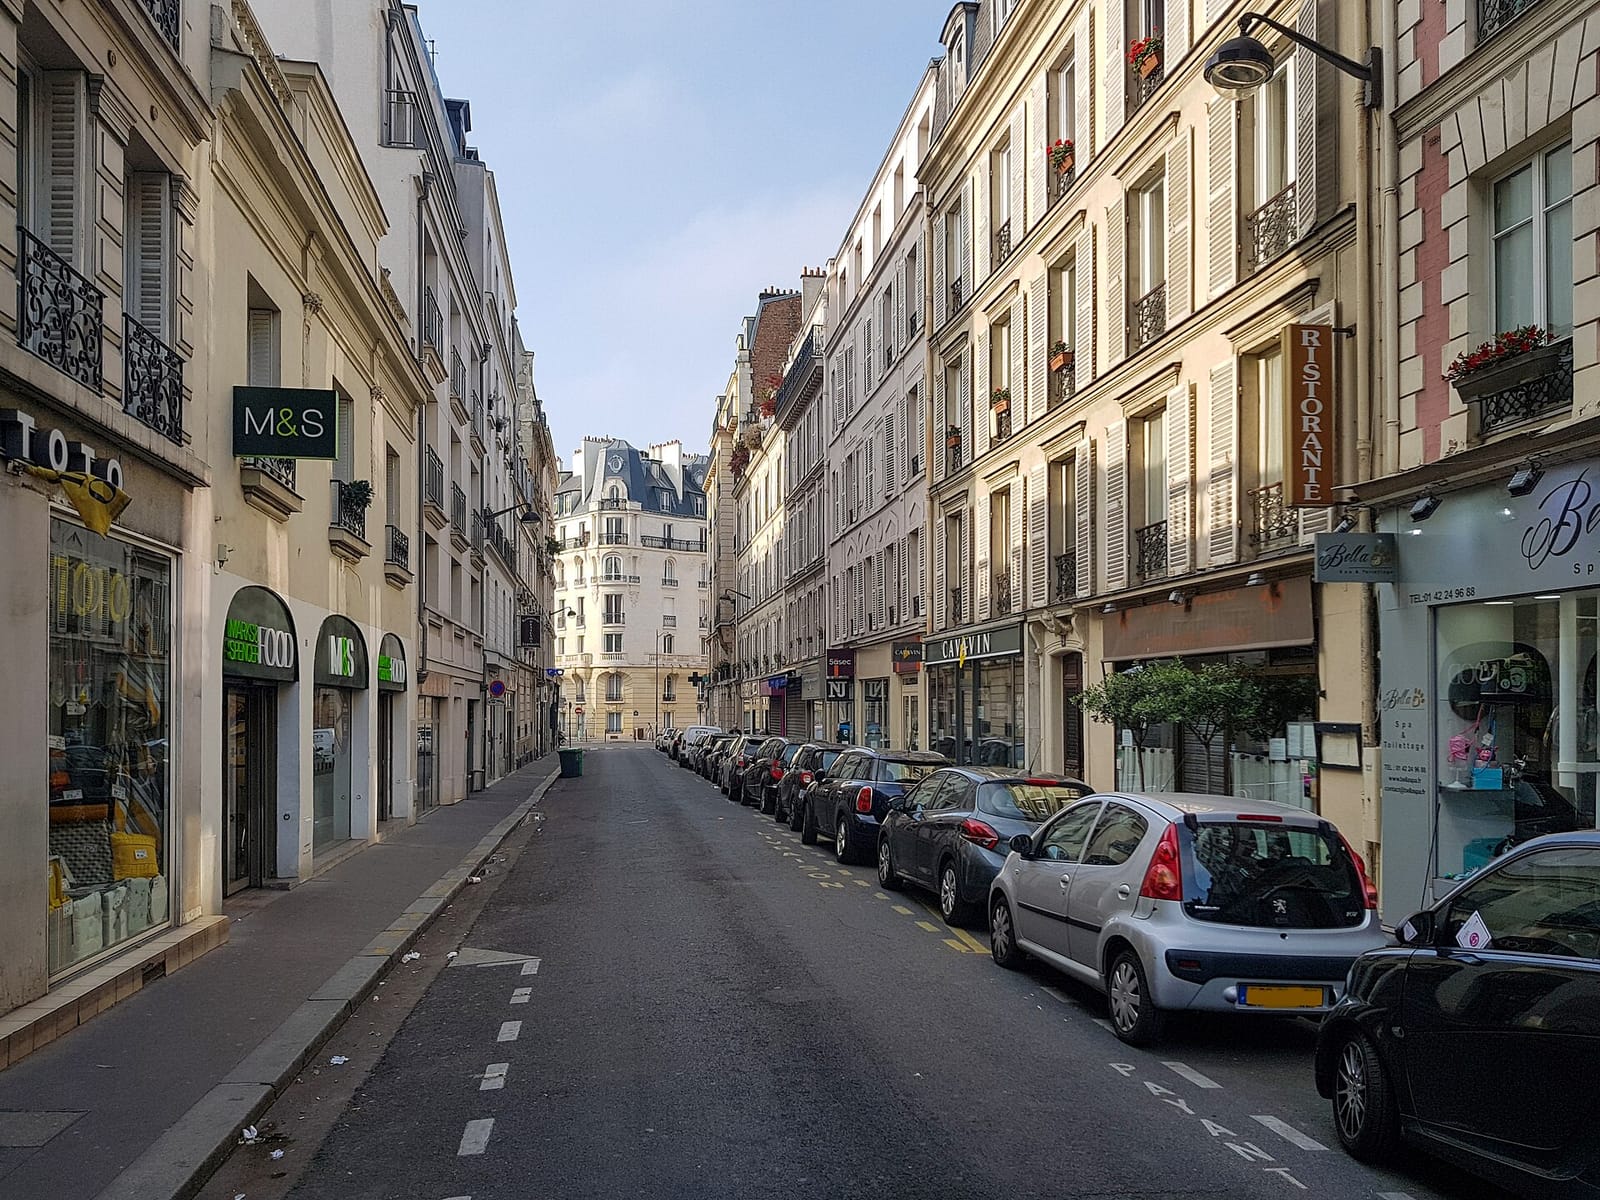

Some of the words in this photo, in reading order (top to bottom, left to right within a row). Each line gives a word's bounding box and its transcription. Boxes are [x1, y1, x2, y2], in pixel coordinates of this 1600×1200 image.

[245, 406, 324, 438] M&S
[1300, 329, 1324, 501] RISTORANTE
[16, 409, 124, 492] TOTO
[1319, 542, 1370, 571] Bella
[1433, 591, 1443, 601] 42
[1444, 589, 1453, 600] 24
[1455, 588, 1464, 598] 96
[1466, 587, 1476, 597] 88
[258, 626, 294, 668] FOOD
[329, 635, 355, 678] M&S
[1383, 688, 1412, 712] Bella
[1394, 720, 1412, 730] Spa
[1383, 740, 1425, 752] Toilettage
[1109, 1062, 1309, 1190] PAYANT
